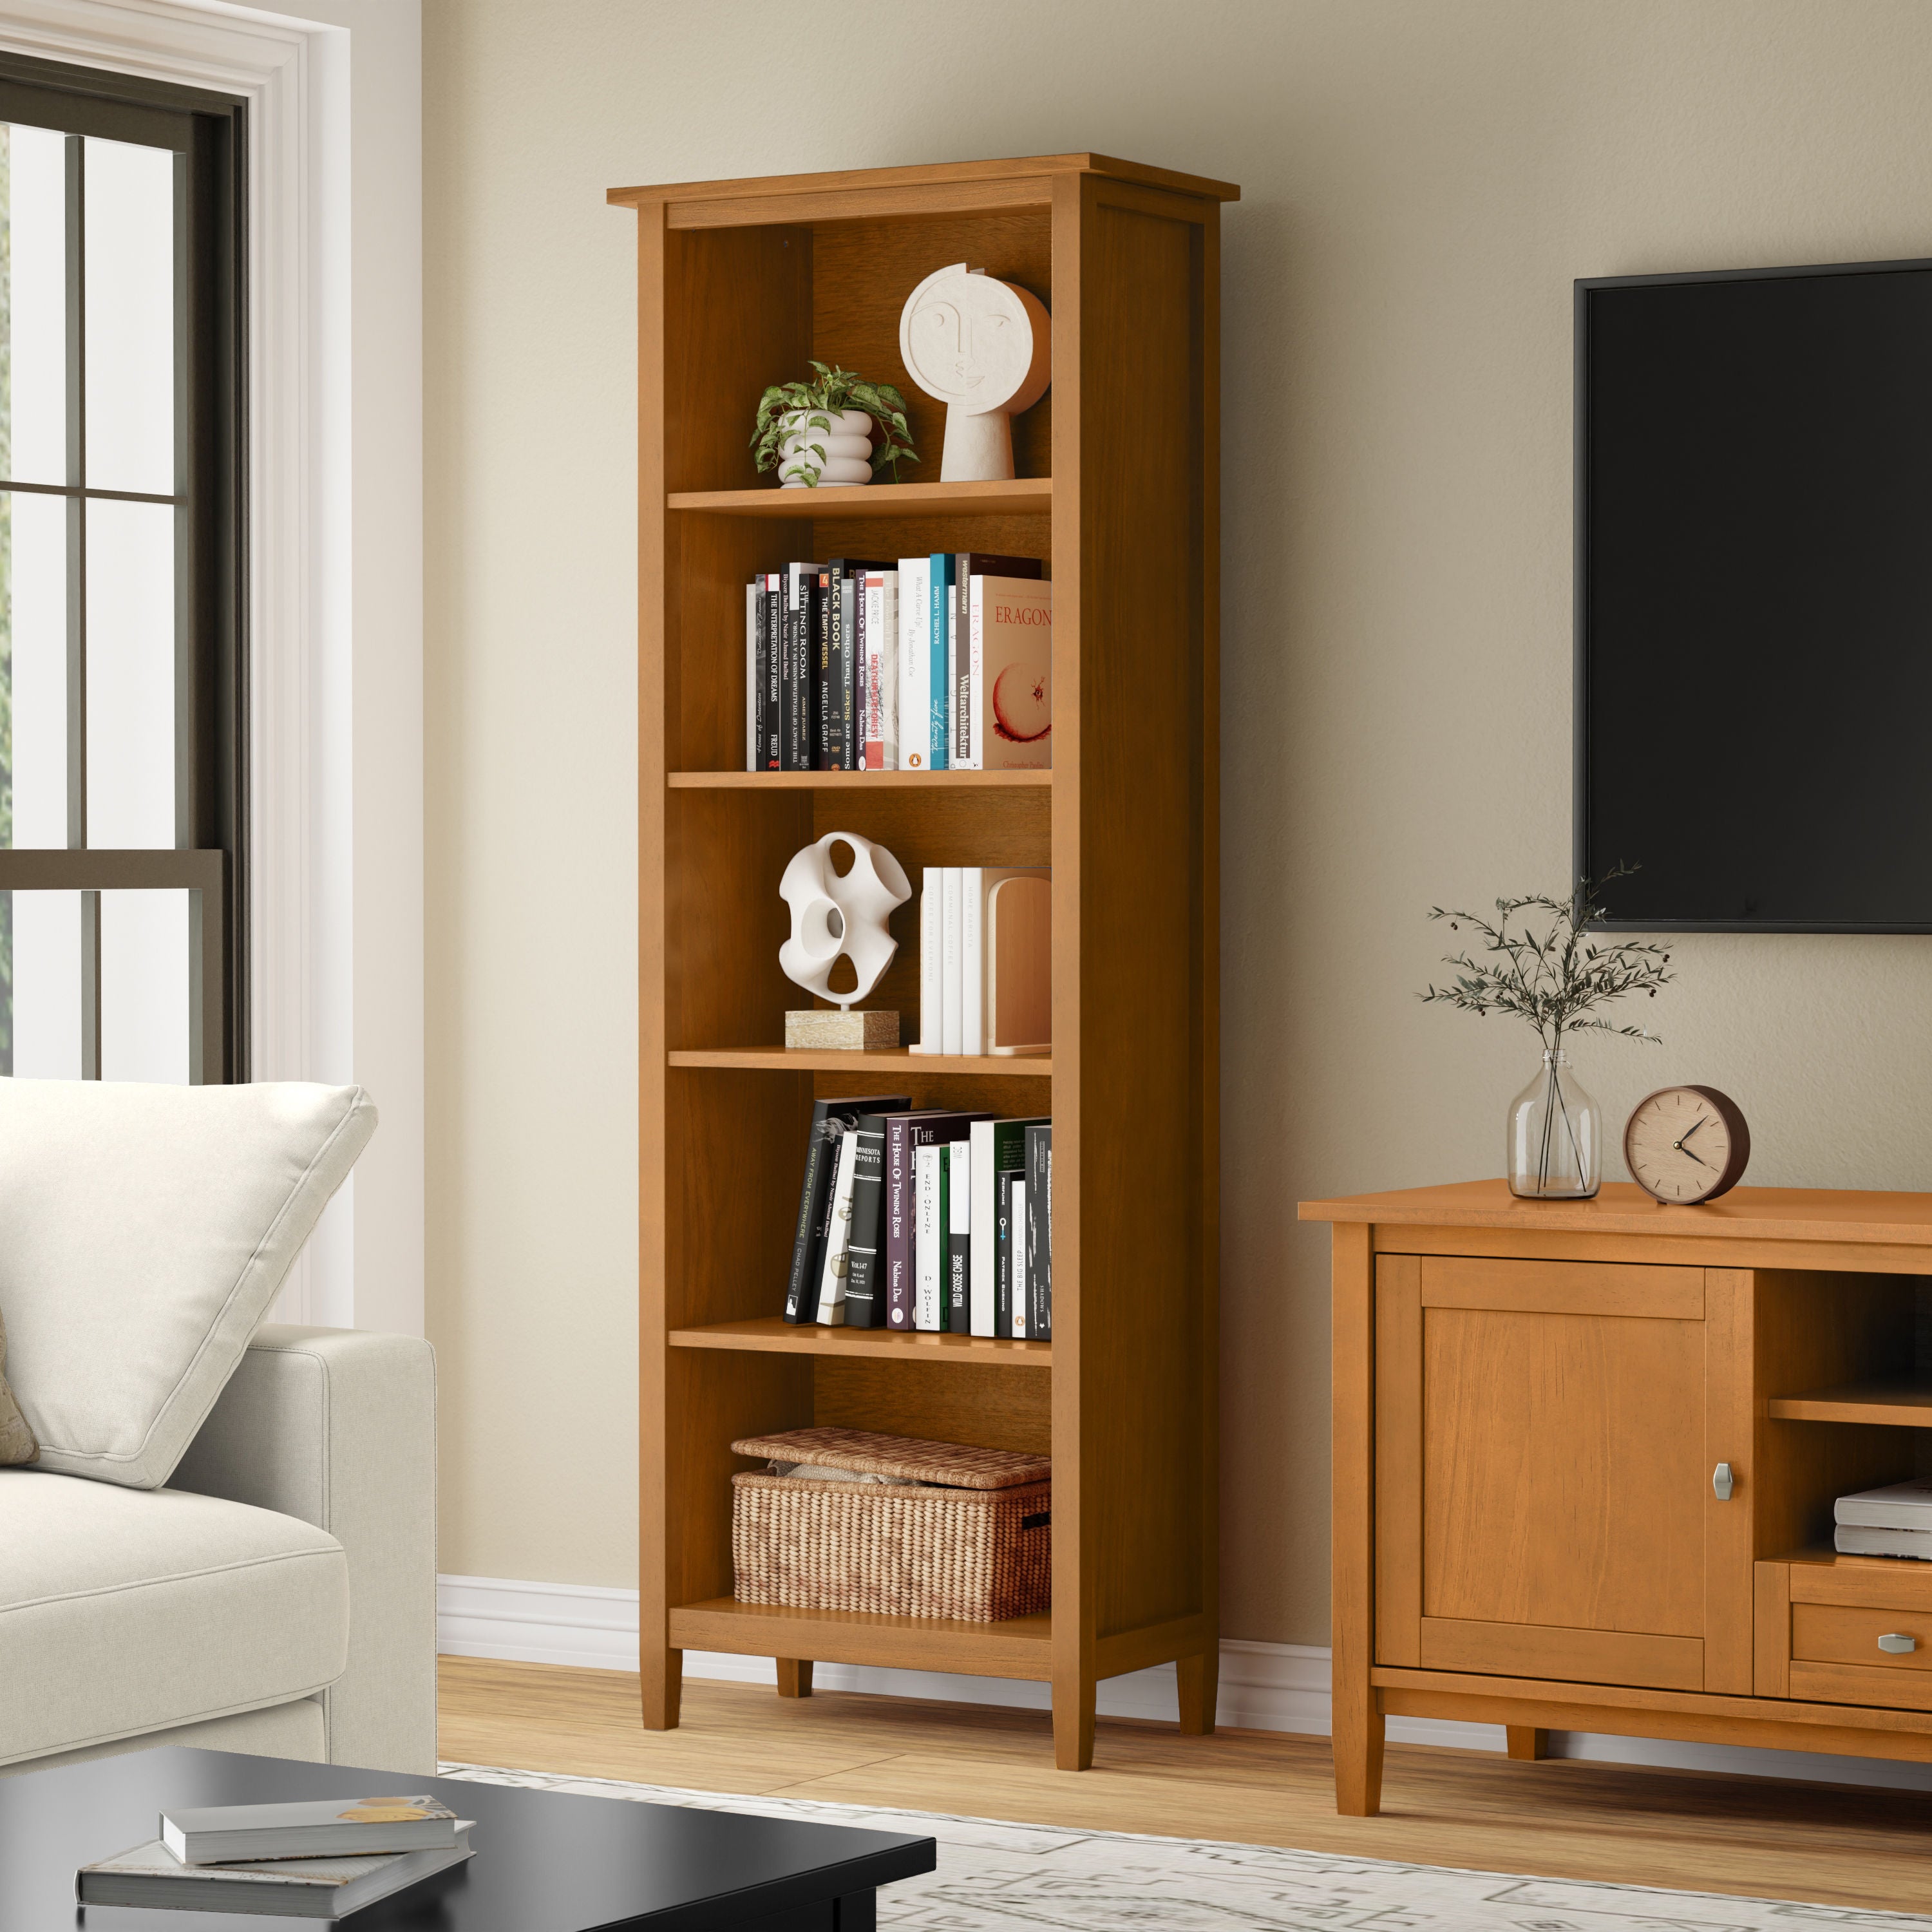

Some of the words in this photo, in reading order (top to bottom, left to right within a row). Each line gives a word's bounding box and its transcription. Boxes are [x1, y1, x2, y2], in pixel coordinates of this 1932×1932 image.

[822, 575, 828, 585] 4
[832, 567, 840, 609] BLACK
[782, 614, 788, 623] by
[996, 605, 1052, 626] ERAGON
[832, 613, 840, 650] BOOK
[907, 629, 915, 637] By
[771, 664, 777, 674] OF
[960, 674, 969, 759] Weltarchitektur
[1003, 761, 1028, 769] Christopher
[911, 1126, 934, 1145] THE
[855, 1154, 880, 1164] REPORTS
[799, 1191, 811, 1238] EVERYWHERE
[953, 1255, 963, 1273] CHASE
[791, 1268, 800, 1292] PELLEY
[893, 1260, 902, 1287] Nabina
[953, 1273, 963, 1293] GOOSE
[893, 1288, 902, 1302] Das
[953, 1293, 963, 1307] WILD
